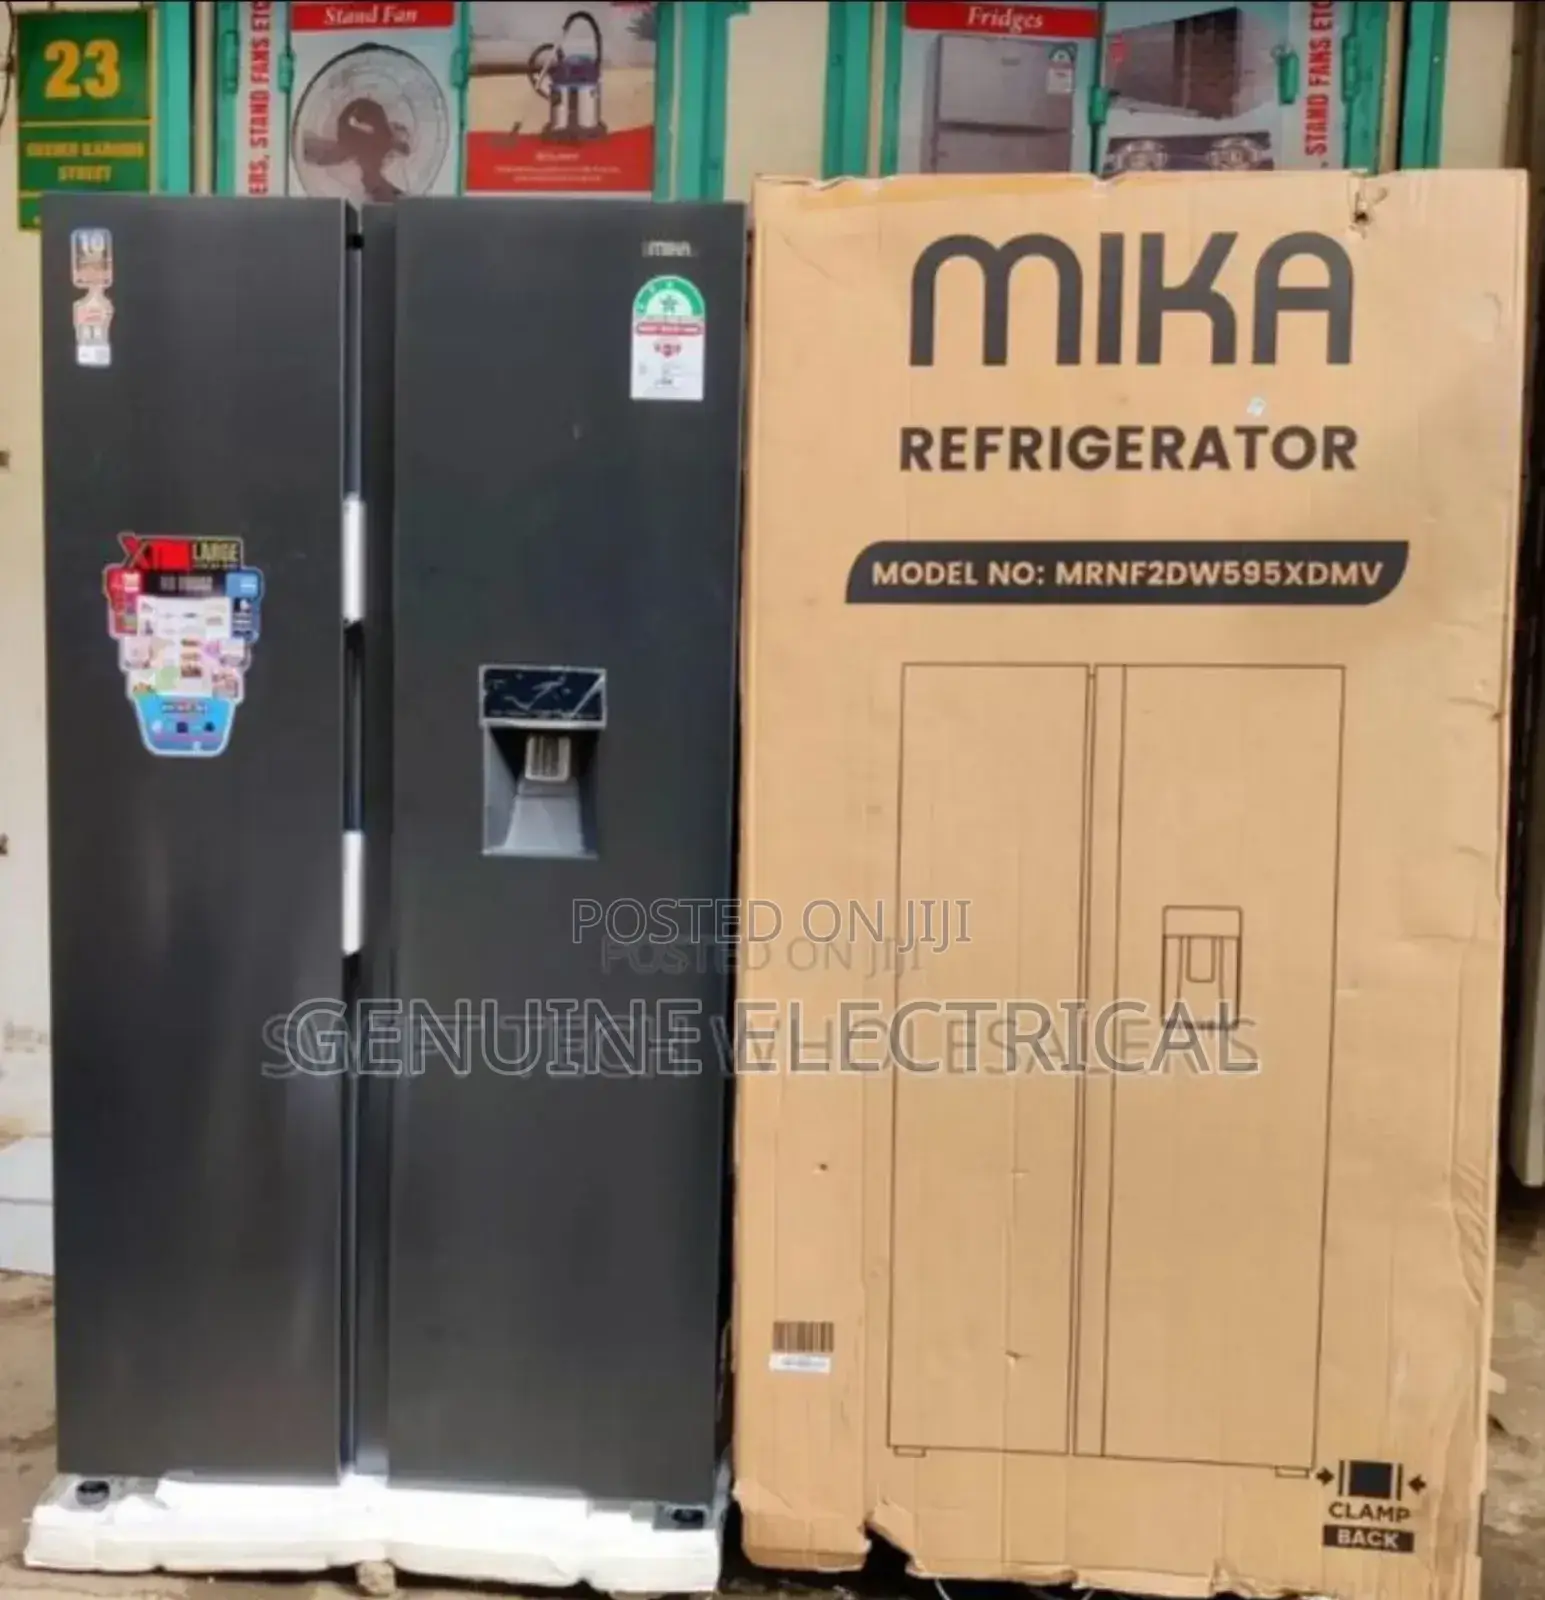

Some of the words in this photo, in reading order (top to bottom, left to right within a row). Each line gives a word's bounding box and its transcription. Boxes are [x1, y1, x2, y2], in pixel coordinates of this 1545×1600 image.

[324, 4, 378, 25] Stand
[383, 5, 418, 23] Fan
[966, 6, 1043, 34] Fridges
[44, 40, 120, 98] 23
[252, 37, 269, 84] FANS
[1308, 37, 1332, 86] FANS
[250, 91, 268, 148] STAND
[1305, 94, 1329, 156] STAND
[909, 231, 1354, 367] MIKA
[900, 425, 1358, 472] REFRIGERATOR
[872, 561, 978, 586] MODEL
[988, 562, 1045, 586] NO:
[1055, 560, 1384, 587] MRNF2DW595XDMV
[1328, 1502, 1411, 1523] CLAMP
[1337, 1529, 1400, 1548] BACK
